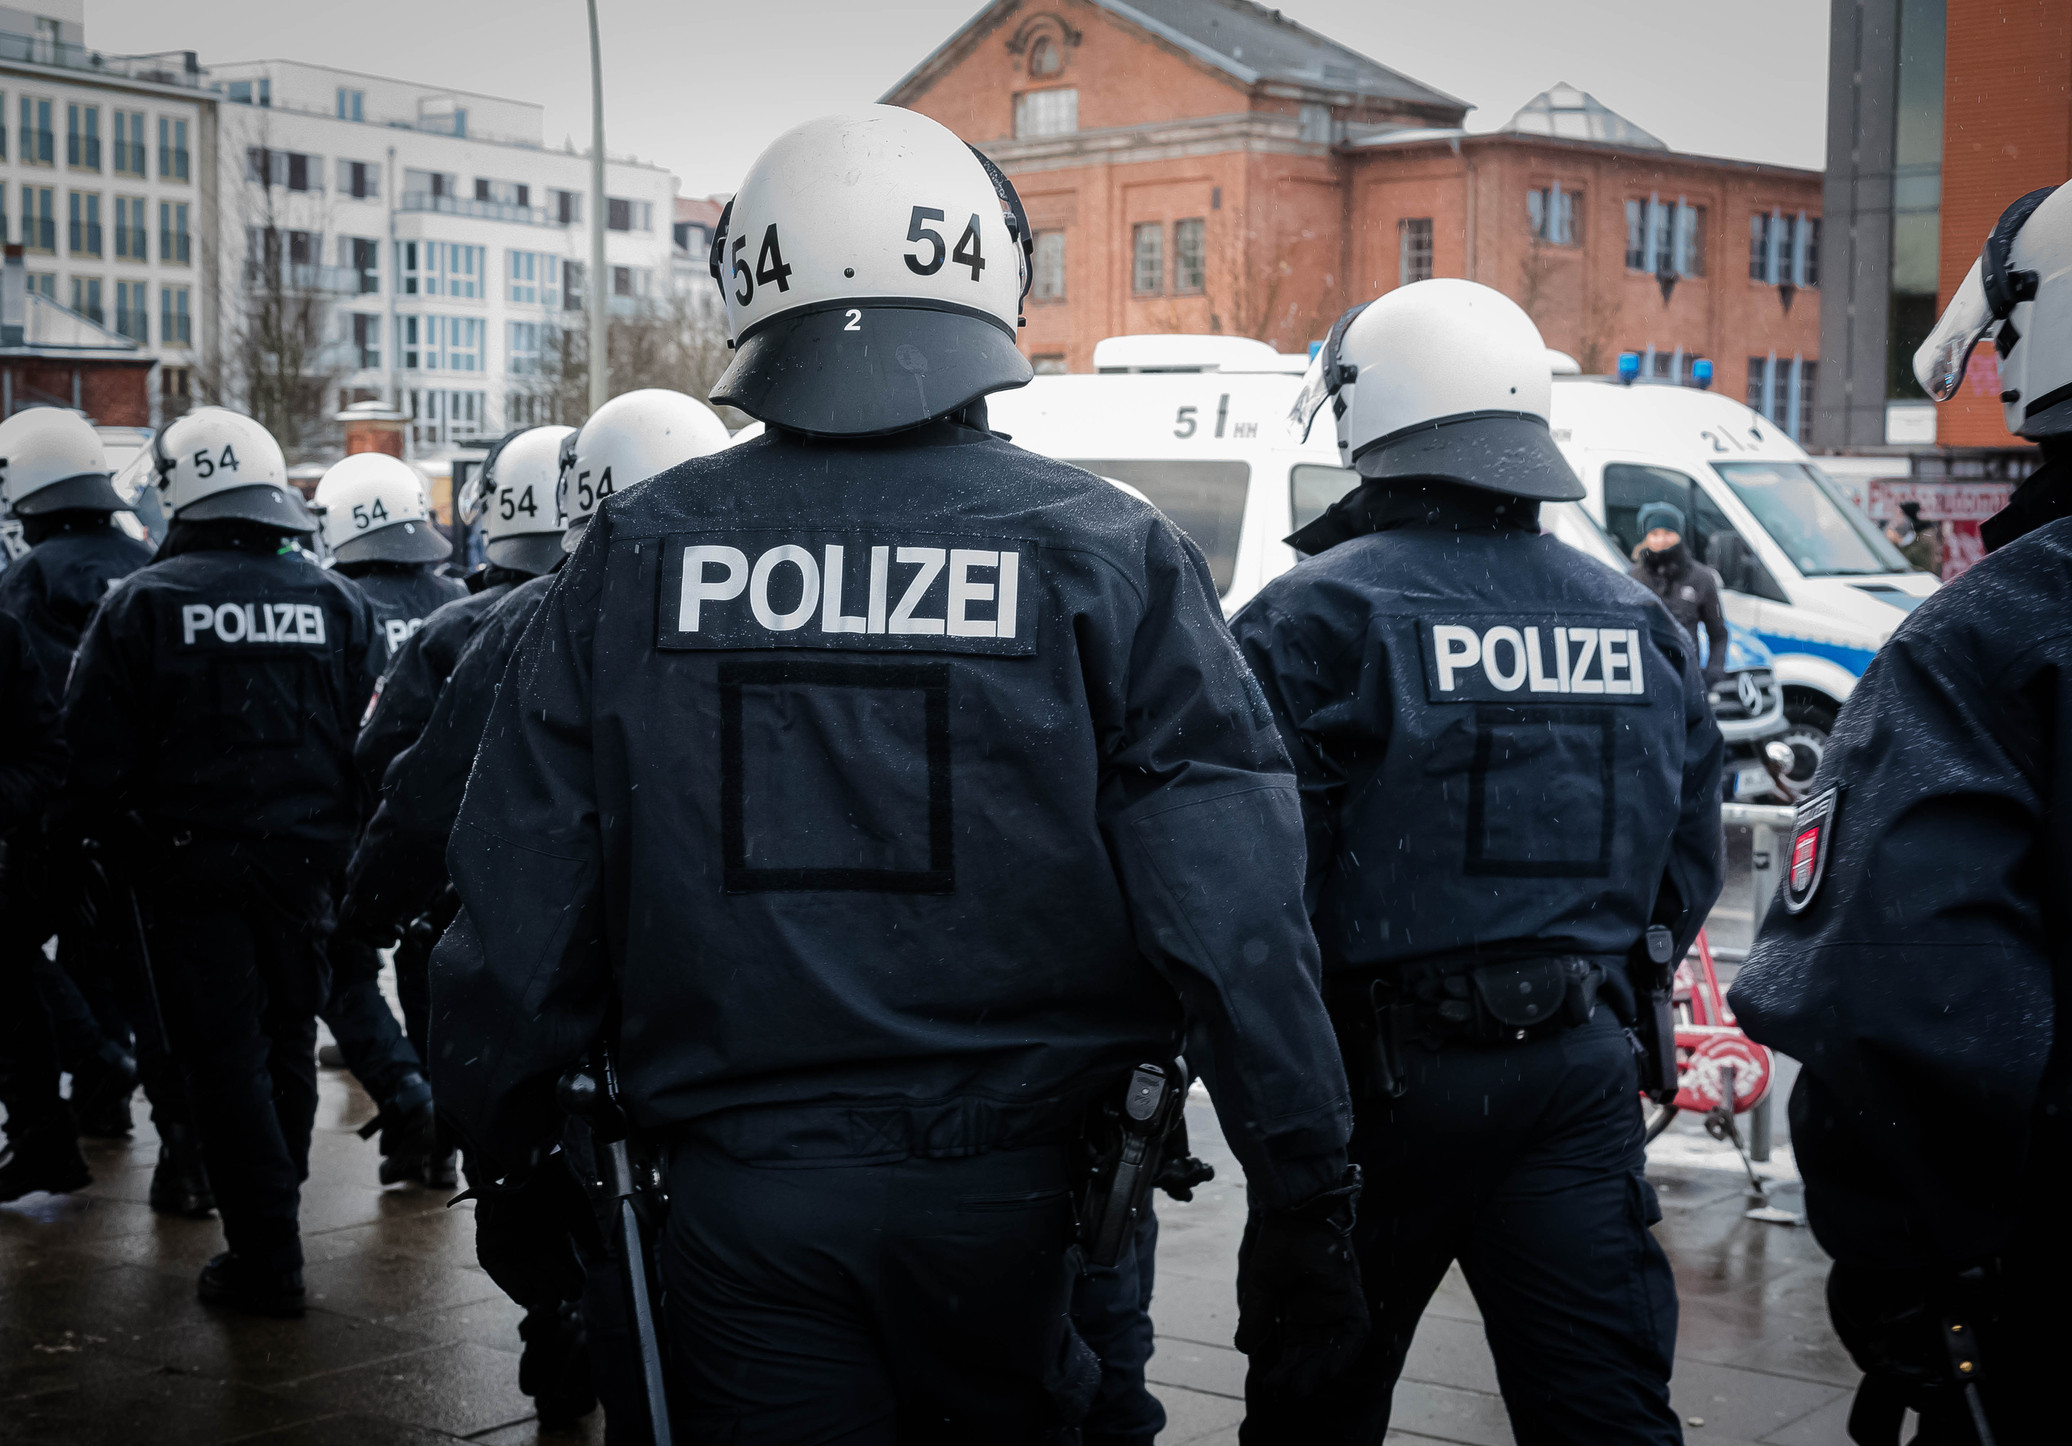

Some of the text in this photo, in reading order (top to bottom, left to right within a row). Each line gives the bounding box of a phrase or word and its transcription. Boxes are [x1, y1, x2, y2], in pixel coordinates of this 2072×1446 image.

[731, 222, 792, 307] 54
[903, 205, 986, 282] 54
[843, 308, 863, 332] 2
[194, 444, 240, 479] 54
[501, 485, 538, 520] 54
[579, 466, 616, 511] 54
[353, 498, 389, 529] 54
[678, 543, 1020, 639] POLIZEI
[182, 602, 327, 646] POLIZEI
[1432, 623, 1645, 696] POLIZEI
